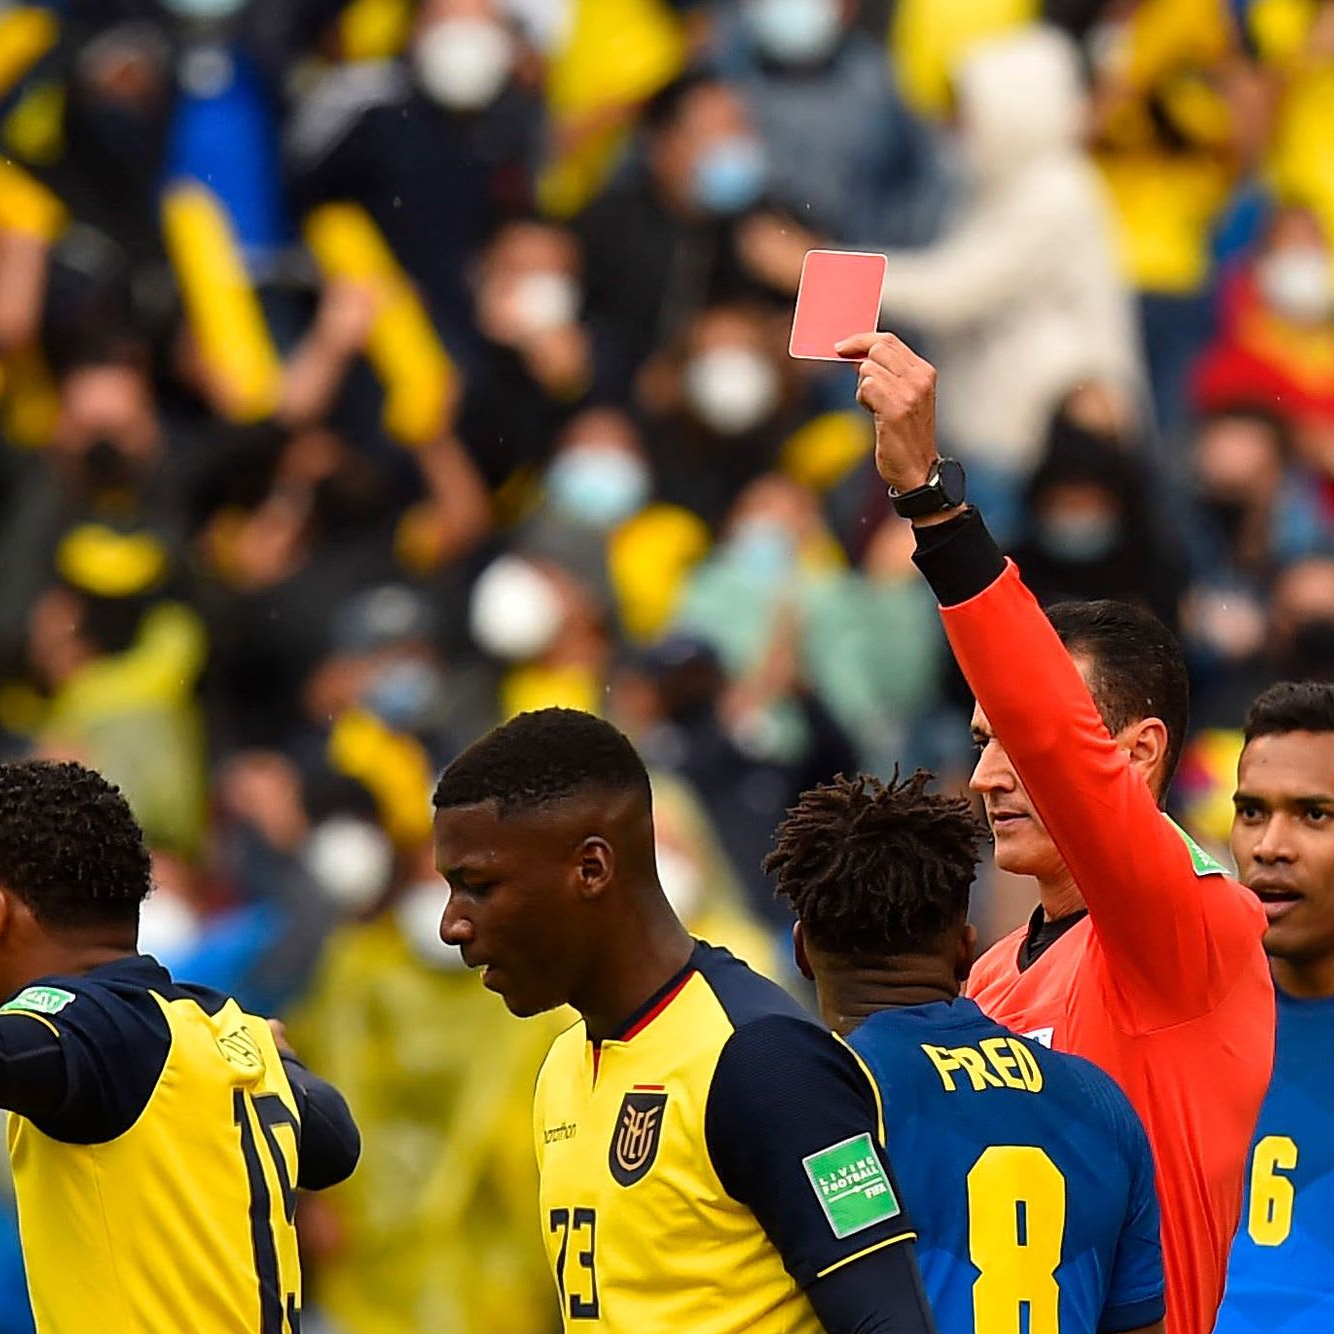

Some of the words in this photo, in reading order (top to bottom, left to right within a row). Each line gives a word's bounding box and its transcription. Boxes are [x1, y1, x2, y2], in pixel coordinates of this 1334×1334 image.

[920, 1037, 1044, 1093] FRED
[818, 1156, 875, 1187] LIVING
[822, 1165, 880, 1196] FOOTBALL
[864, 1183, 888, 1199] FIFA
[1249, 1136, 1297, 1247] 6
